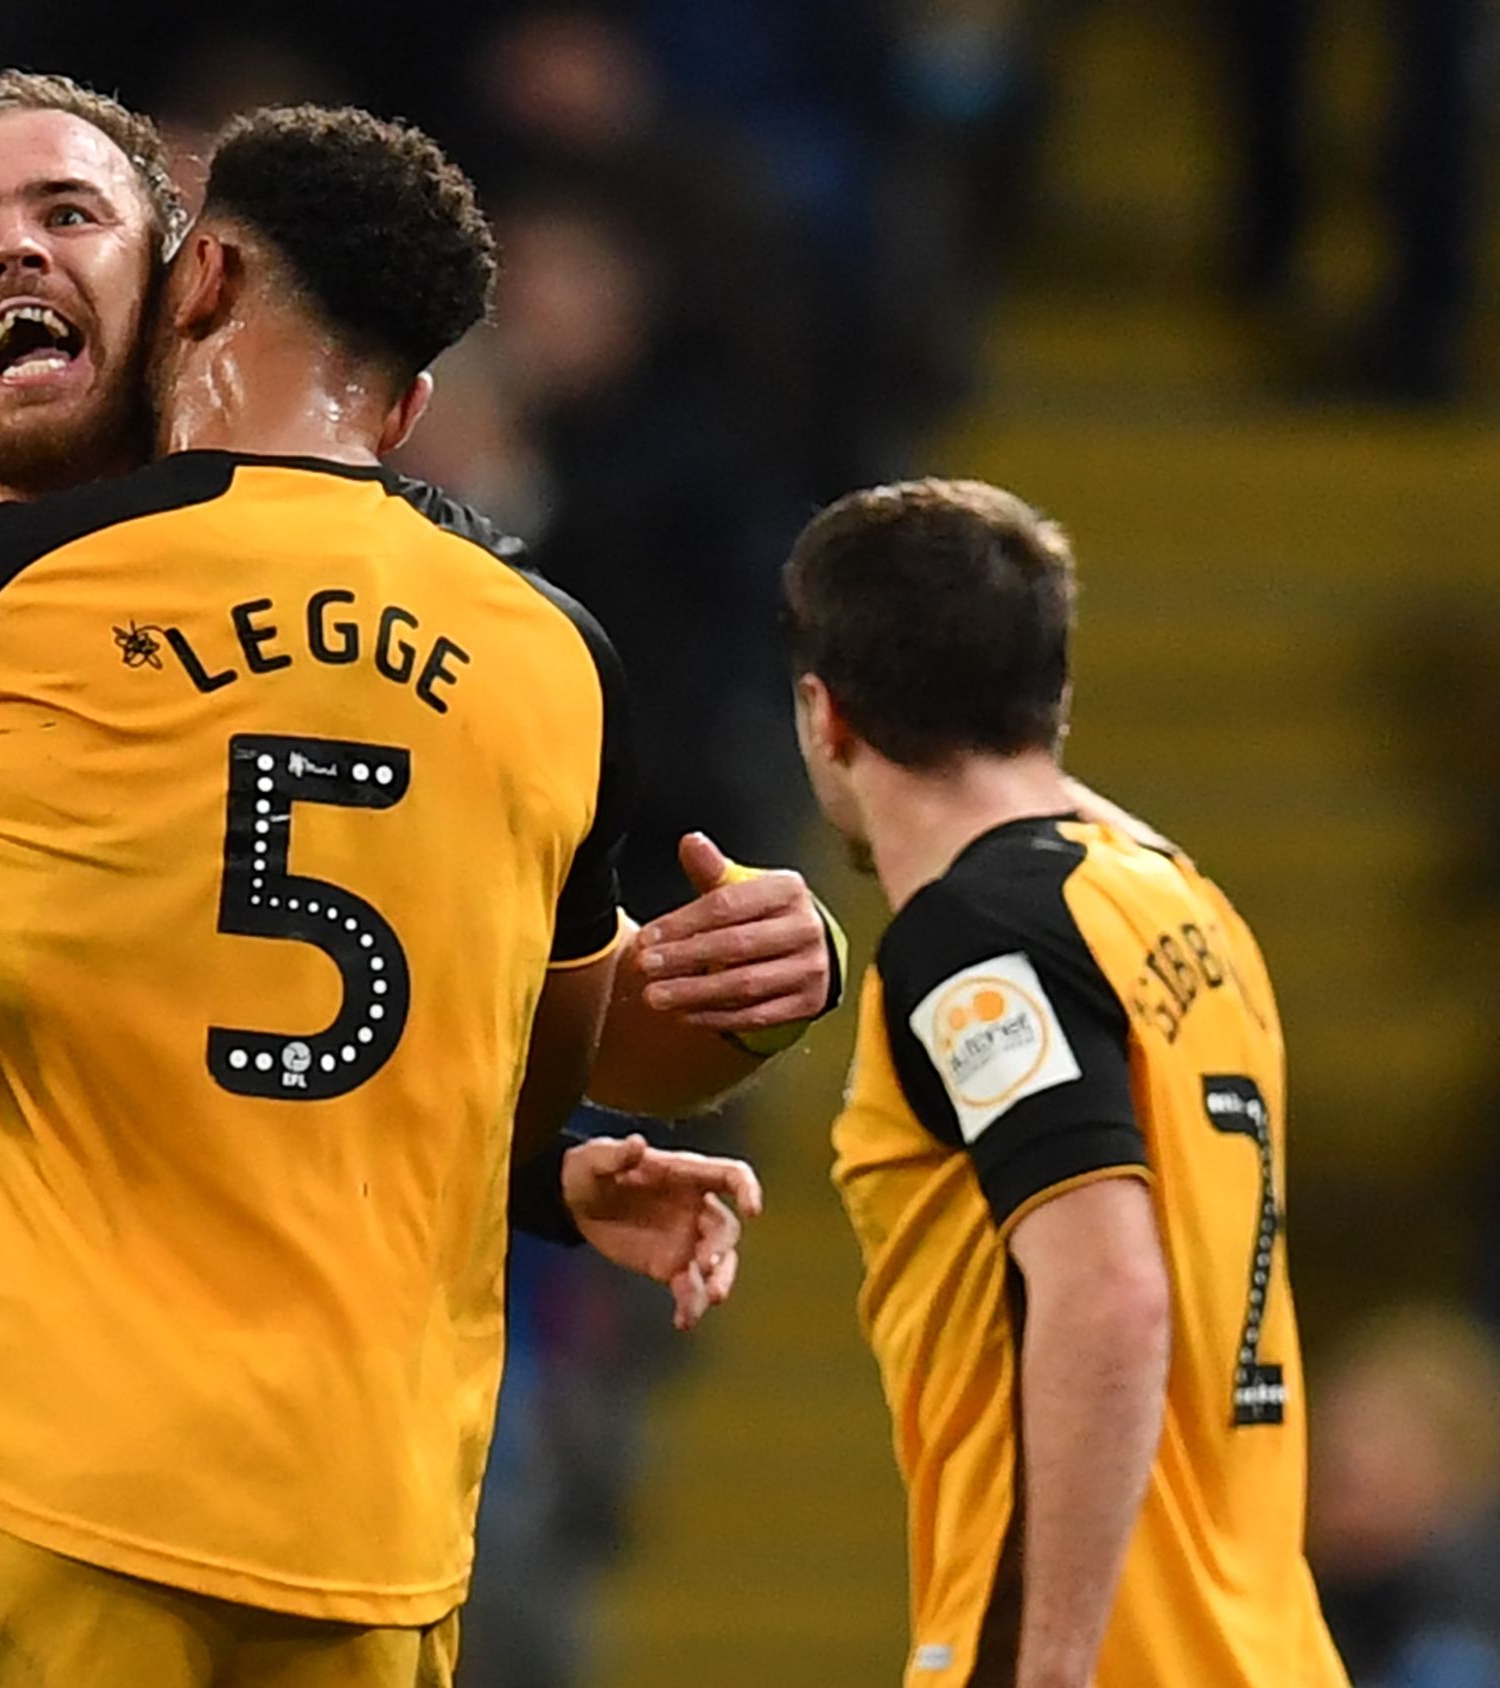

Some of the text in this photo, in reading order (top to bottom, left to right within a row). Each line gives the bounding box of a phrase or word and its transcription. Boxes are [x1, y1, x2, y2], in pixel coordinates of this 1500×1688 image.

[165, 589, 471, 714] LEGGE
[206, 733, 411, 1101] 5
[1131, 922, 1238, 1044] GIBB
[282, 1071, 308, 1089] EFL
[1199, 1073, 1286, 1426] 2
